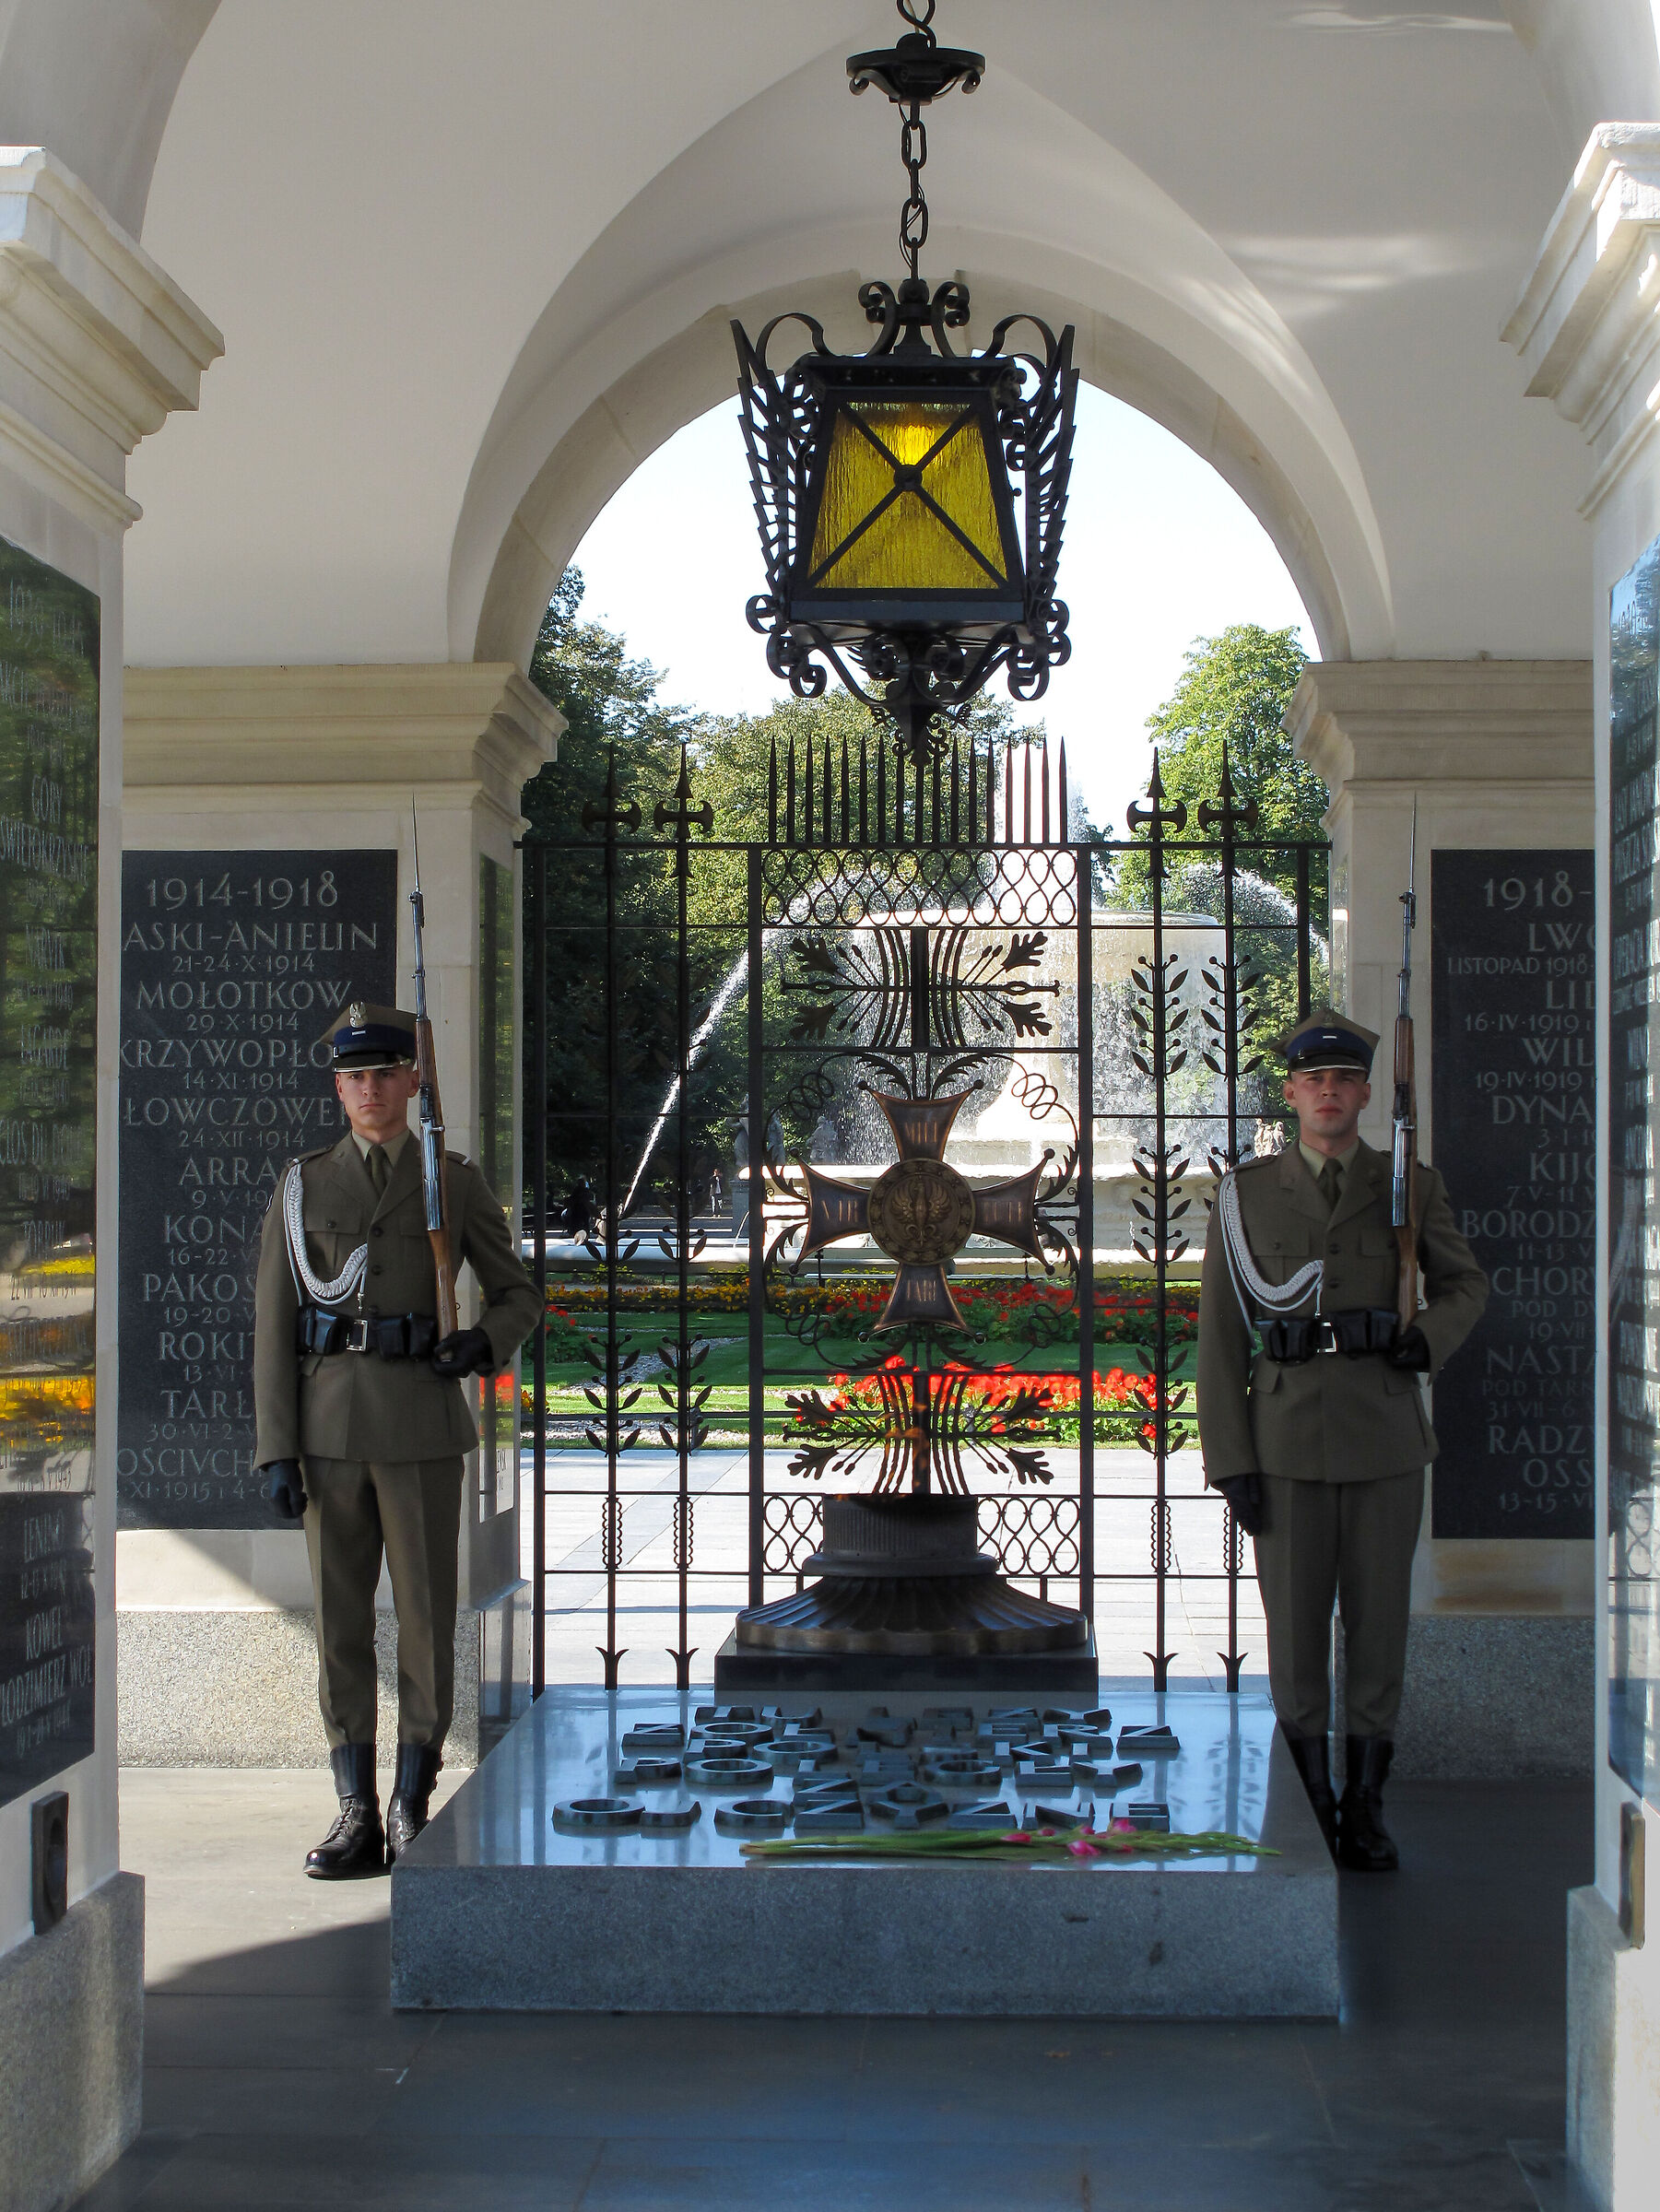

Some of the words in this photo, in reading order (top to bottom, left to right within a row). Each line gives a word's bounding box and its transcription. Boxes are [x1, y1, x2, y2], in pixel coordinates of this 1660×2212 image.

[147, 870, 338, 911] 1914-1918
[1448, 957, 1540, 973] LISTOPAD
[1522, 1038, 1594, 1066] WIL
[1492, 1095, 1594, 1124] DYNA
[178, 1154, 289, 1186] ARRA
[1512, 1300, 1557, 1318] POD
[1482, 1380, 1526, 1396] POD
[1489, 1425, 1595, 1454] RADZ
[26, 1606, 64, 1661] KOWEL
